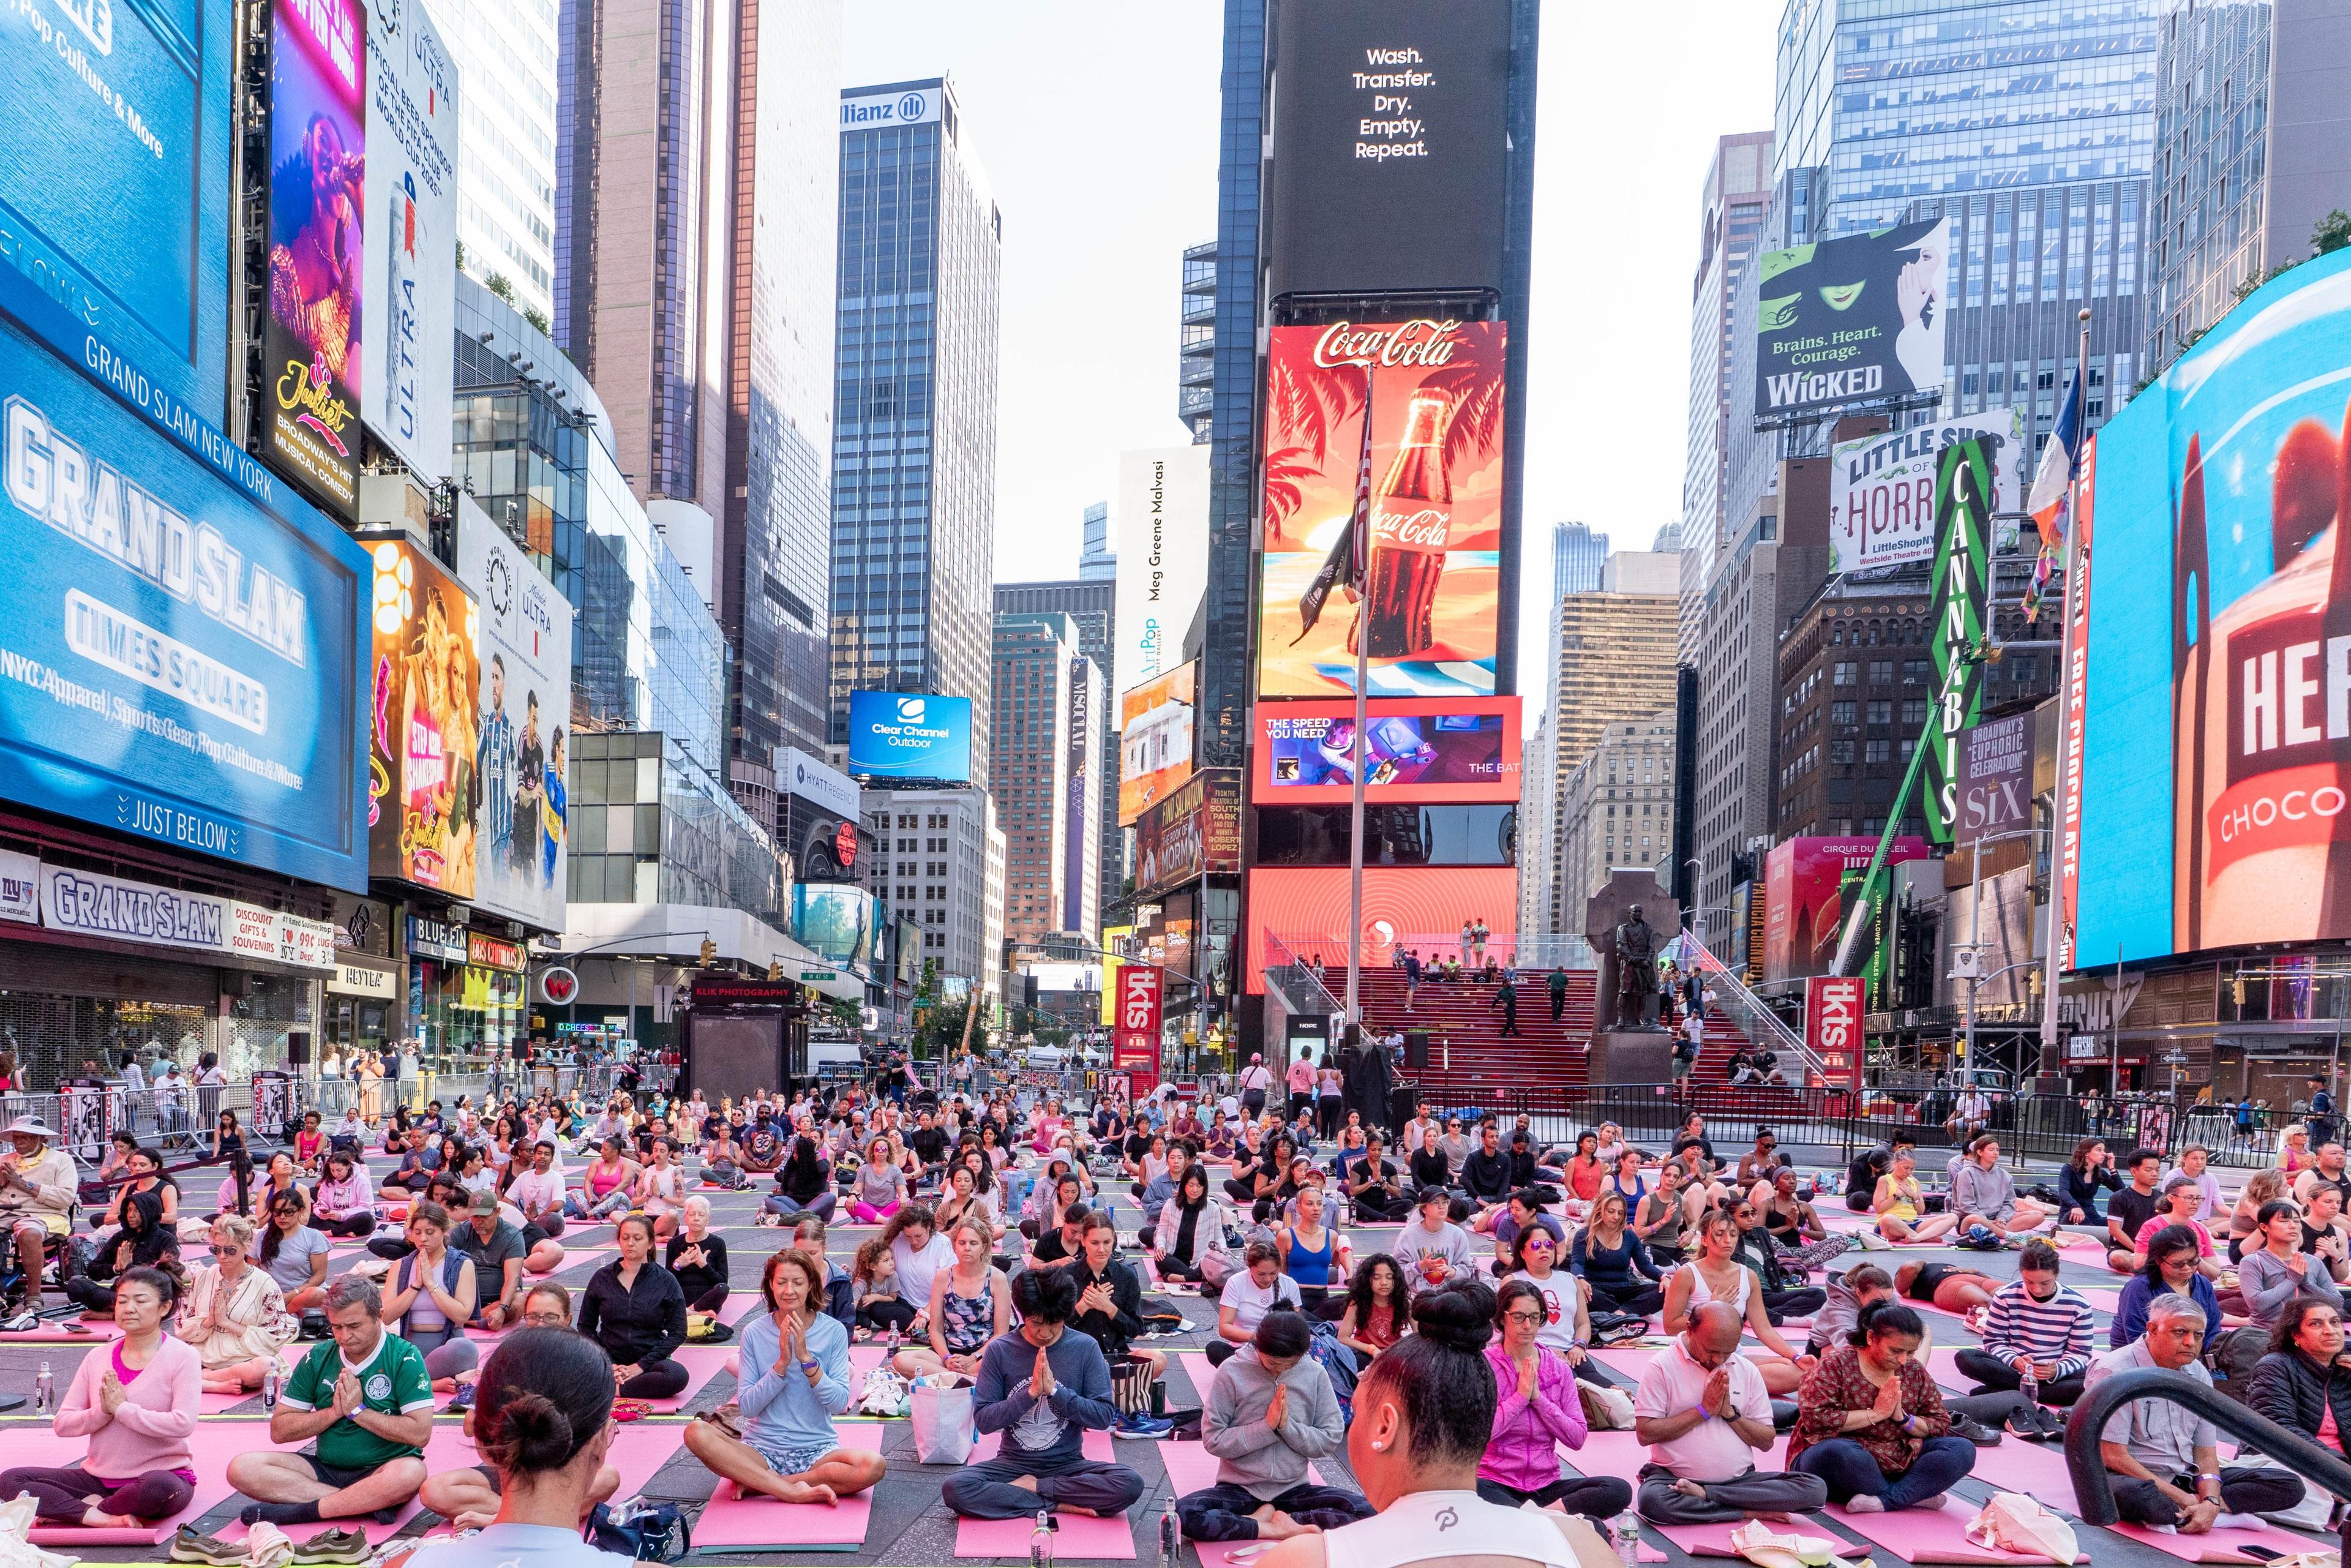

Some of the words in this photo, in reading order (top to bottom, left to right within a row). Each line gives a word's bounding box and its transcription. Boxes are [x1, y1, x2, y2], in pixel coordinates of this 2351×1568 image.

[414, 32, 452, 112] ULTRA
[1367, 48, 1423, 66] Wash.
[1352, 70, 1436, 89] Transfer.
[56, 31, 112, 106] Culture
[114, 93, 125, 122] &
[127, 105, 163, 160] More
[1374, 95, 1412, 116] Dry.
[376, 91, 403, 144] WORLD
[405, 140, 420, 167] CUP
[378, 74, 389, 98] OF
[390, 92, 405, 122] THE
[407, 119, 422, 153] FIFA
[423, 146, 440, 181] CLUB
[402, 88, 419, 128] BEER
[421, 121, 452, 181] SPONSOR
[1360, 118, 1425, 139] Empty.
[1355, 140, 1428, 163] Repeat.
[1313, 318, 1463, 369] Coca-Cola
[1772, 336, 1828, 355] Brains.
[1832, 325, 1882, 345] Heart.
[400, 279, 415, 440] ULTRA
[1791, 347, 1862, 366] Courage.
[310, 351, 332, 399] &
[276, 359, 355, 433] Juliet
[85, 335, 149, 408] GRAND
[154, 389, 198, 448] SLAM
[203, 423, 234, 475] NEW
[238, 448, 273, 505] YORK
[277, 413, 339, 474] BROADWAY'S
[339, 464, 353, 486] HIT
[1849, 429, 1935, 486] LITTLE
[275, 432, 317, 476] MUSICAL
[318, 468, 354, 505] COMEDY
[1912, 461, 1930, 472] OF
[1150, 461, 1164, 514] Malvasi
[490, 546, 506, 563] WORLD
[1149, 517, 1162, 567] Greene
[1859, 555, 1892, 565] Westside
[1893, 551, 1921, 560] Theatre
[1148, 571, 1163, 602] Meg
[522, 592, 552, 637] ULTRA
[72, 598, 165, 679] TIMES
[168, 648, 262, 726] SQUARE
[1140, 618, 1160, 678] ArtPop
[412, 720, 428, 756] STEP
[872, 723, 902, 735] Clear
[903, 726, 950, 738] Channel
[1265, 719, 1290, 729] THE
[1292, 718, 1332, 729] SPEED
[1265, 729, 1291, 739] YOU
[1293, 729, 1326, 739] NEED
[1972, 717, 2024, 745] BROADWAY'S
[888, 736, 932, 748] Outdoor
[1469, 763, 1494, 773] THE
[1497, 762, 1521, 773] BAT
[806, 771, 828, 793] HYATT
[828, 783, 855, 806] REGENCY
[1163, 797, 1174, 827] FIND
[1174, 776, 1204, 820] SALVATION
[1965, 778, 2025, 829] SIX
[132, 800, 173, 838] JUST
[177, 812, 228, 853] BELOW
[2221, 786, 2346, 842] CHOCO
[400, 812, 451, 857] Juliet
[1170, 829, 1182, 845] BOOK
[1182, 824, 1188, 837] OF
[1823, 846, 1858, 855] CIRQUE
[235, 908, 274, 926] DISCOUNT
[1750, 883, 1765, 926] PATRICIA
[239, 923, 260, 937] GIFTS
[261, 928, 267, 938] &
[282, 928, 287, 942] I
[288, 916, 301, 928] Rated
[301, 920, 320, 931] Souvenir
[319, 924, 332, 935] Shop
[299, 931, 315, 949] 99¢
[418, 918, 445, 943] BLUE
[450, 928, 467, 949] FIN
[1166, 932, 1181, 940] Olive
[233, 936, 275, 954] SOUVENIRS
[280, 945, 295, 961] NY
[299, 950, 315, 962] Dept.
[321, 950, 327, 964] 3
[472, 938, 487, 961] DOS
[487, 941, 517, 968] CAMINOS
[1168, 937, 1189, 947] Garden
[1749, 929, 1764, 979] CORNWELL
[545, 976, 572, 999] W
[696, 988, 716, 996] KLIK
[719, 988, 789, 997] PHOTOGRAPHY
[1126, 970, 1157, 1029] tkts
[1820, 982, 1857, 1047] tkts
[254, 1077, 264, 1133] CHICAGO
[1542, 1288, 1561, 1310] Q
[266, 1386, 275, 1405] smart
[367, 1384, 389, 1398] PALMEIRAS
